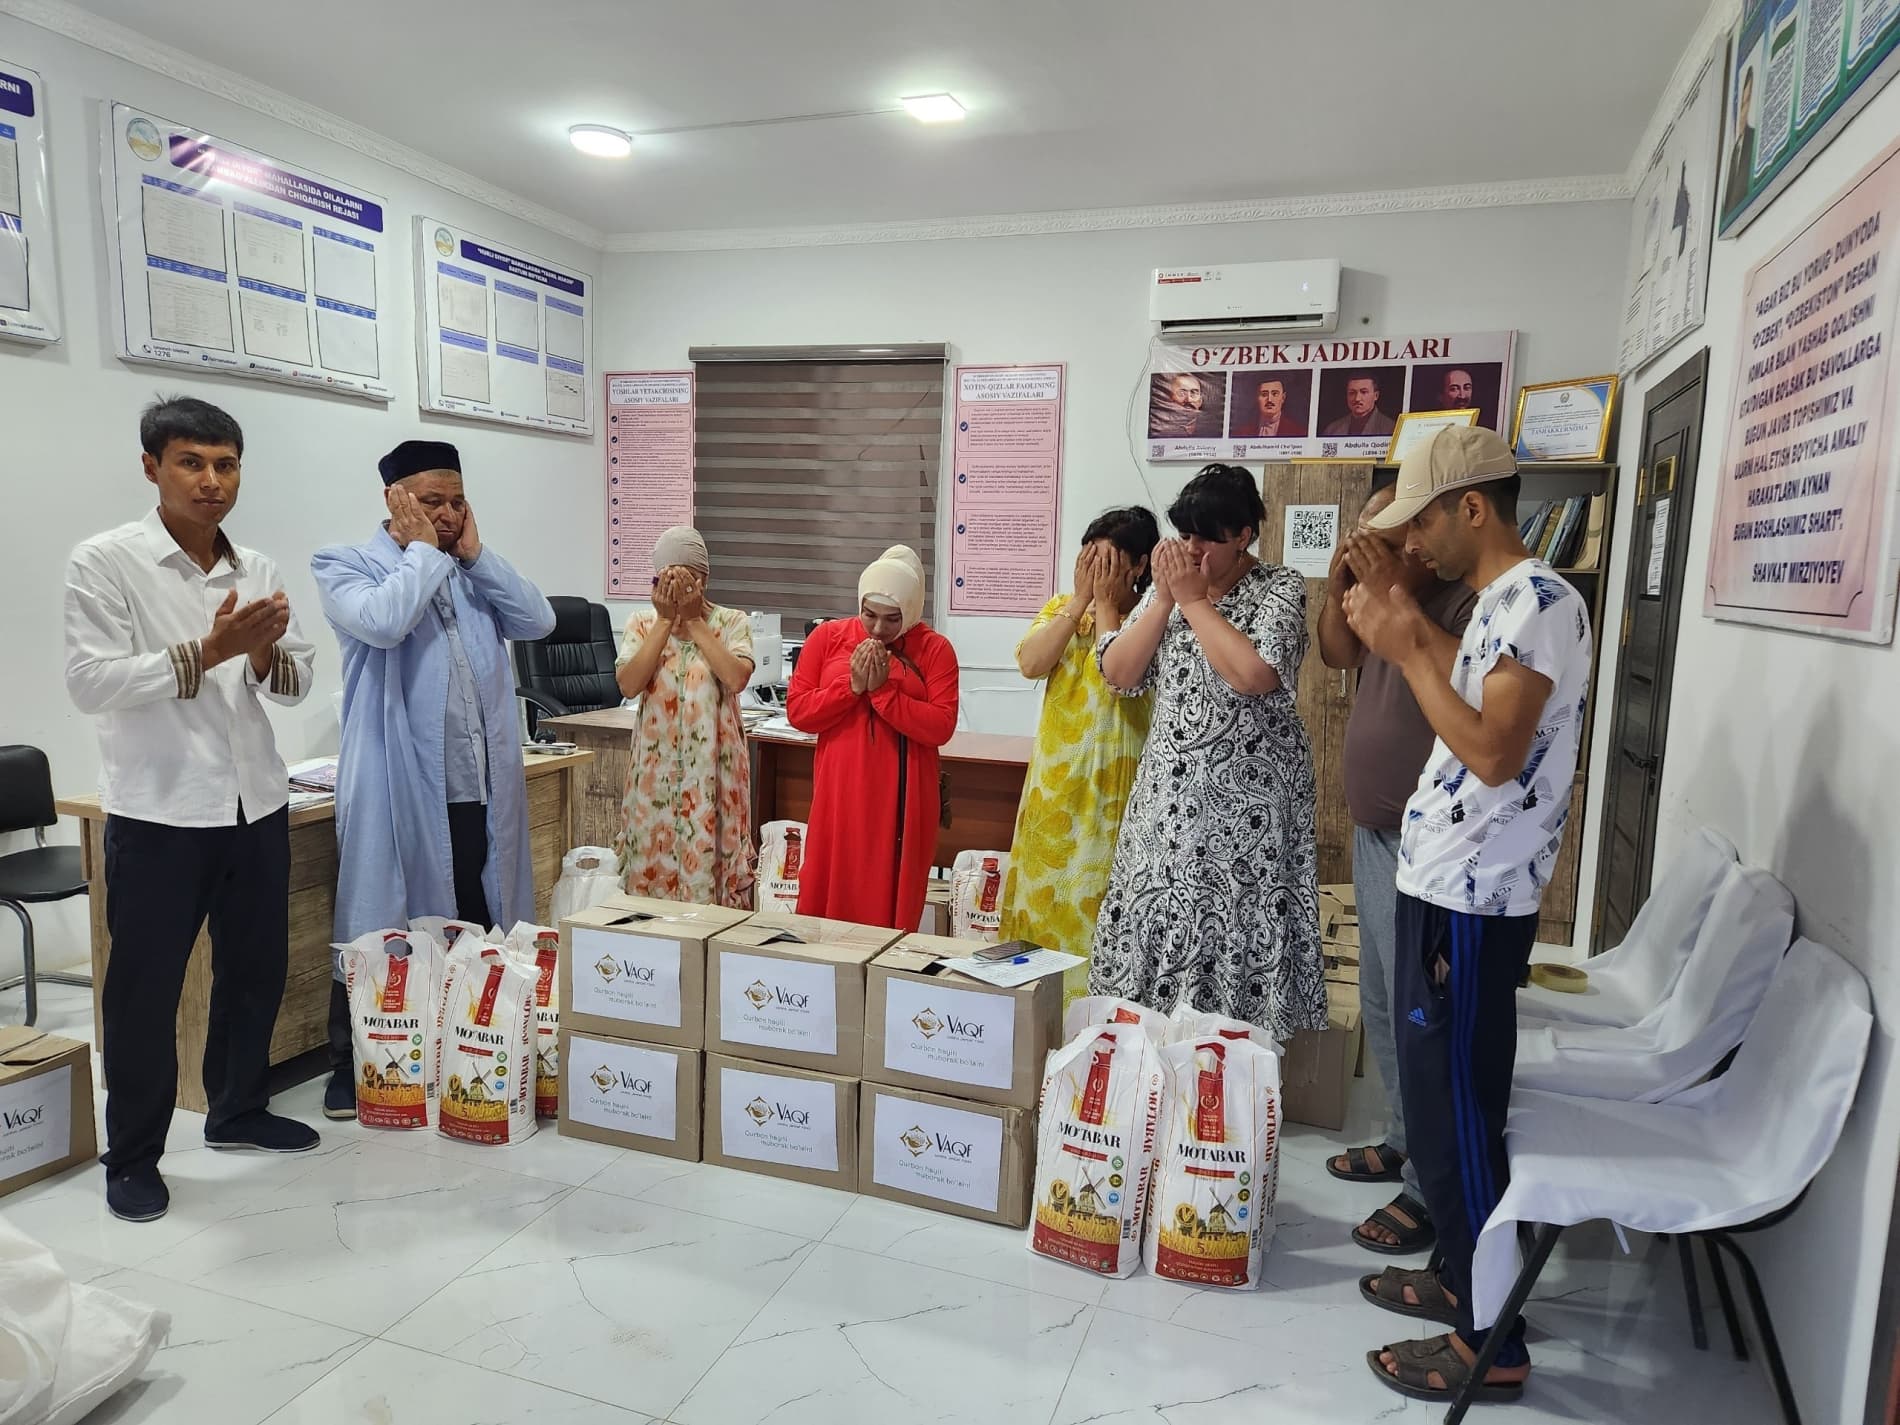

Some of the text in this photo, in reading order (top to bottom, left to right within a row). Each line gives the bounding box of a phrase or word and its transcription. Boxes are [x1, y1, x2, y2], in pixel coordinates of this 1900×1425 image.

[287, 189, 332, 212] CHIQARISH
[332, 203, 360, 221] REJASI
[322, 191, 363, 212] OILALARNI
[1779, 280, 1791, 304] BIZ
[1834, 210, 1880, 264] DUNYODA
[1844, 250, 1880, 294] DEGAN
[1192, 337, 1452, 367] O‘ZBEK JADIDLARI
[1818, 331, 1881, 382] SAVOLLARGA
[963, 382, 1056, 391] XOTIN-QIZLAR FAOLINING
[1002, 391, 1044, 399] VAZIFALARI
[1840, 384, 1854, 411] VA
[1344, 441, 1369, 449] Abdulla
[1768, 445, 1791, 471] ETISH
[1829, 420, 1868, 454] AMALIY
[1747, 471, 1831, 508] HARAKATLARNI AYNAN
[1753, 513, 1808, 539] BOSHLASHIMIZ
[1752, 559, 1845, 584] SHAVKAT MIRZIYOYEV
[624, 960, 657, 981] VAQF
[776, 986, 810, 1008] VAQF
[947, 1014, 985, 1038] VAQF
[620, 1070, 653, 1093] VAQF
[3, 1103, 45, 1130] VAQF
[776, 1102, 811, 1125] VAQF
[935, 1132, 974, 1158] VAQF
